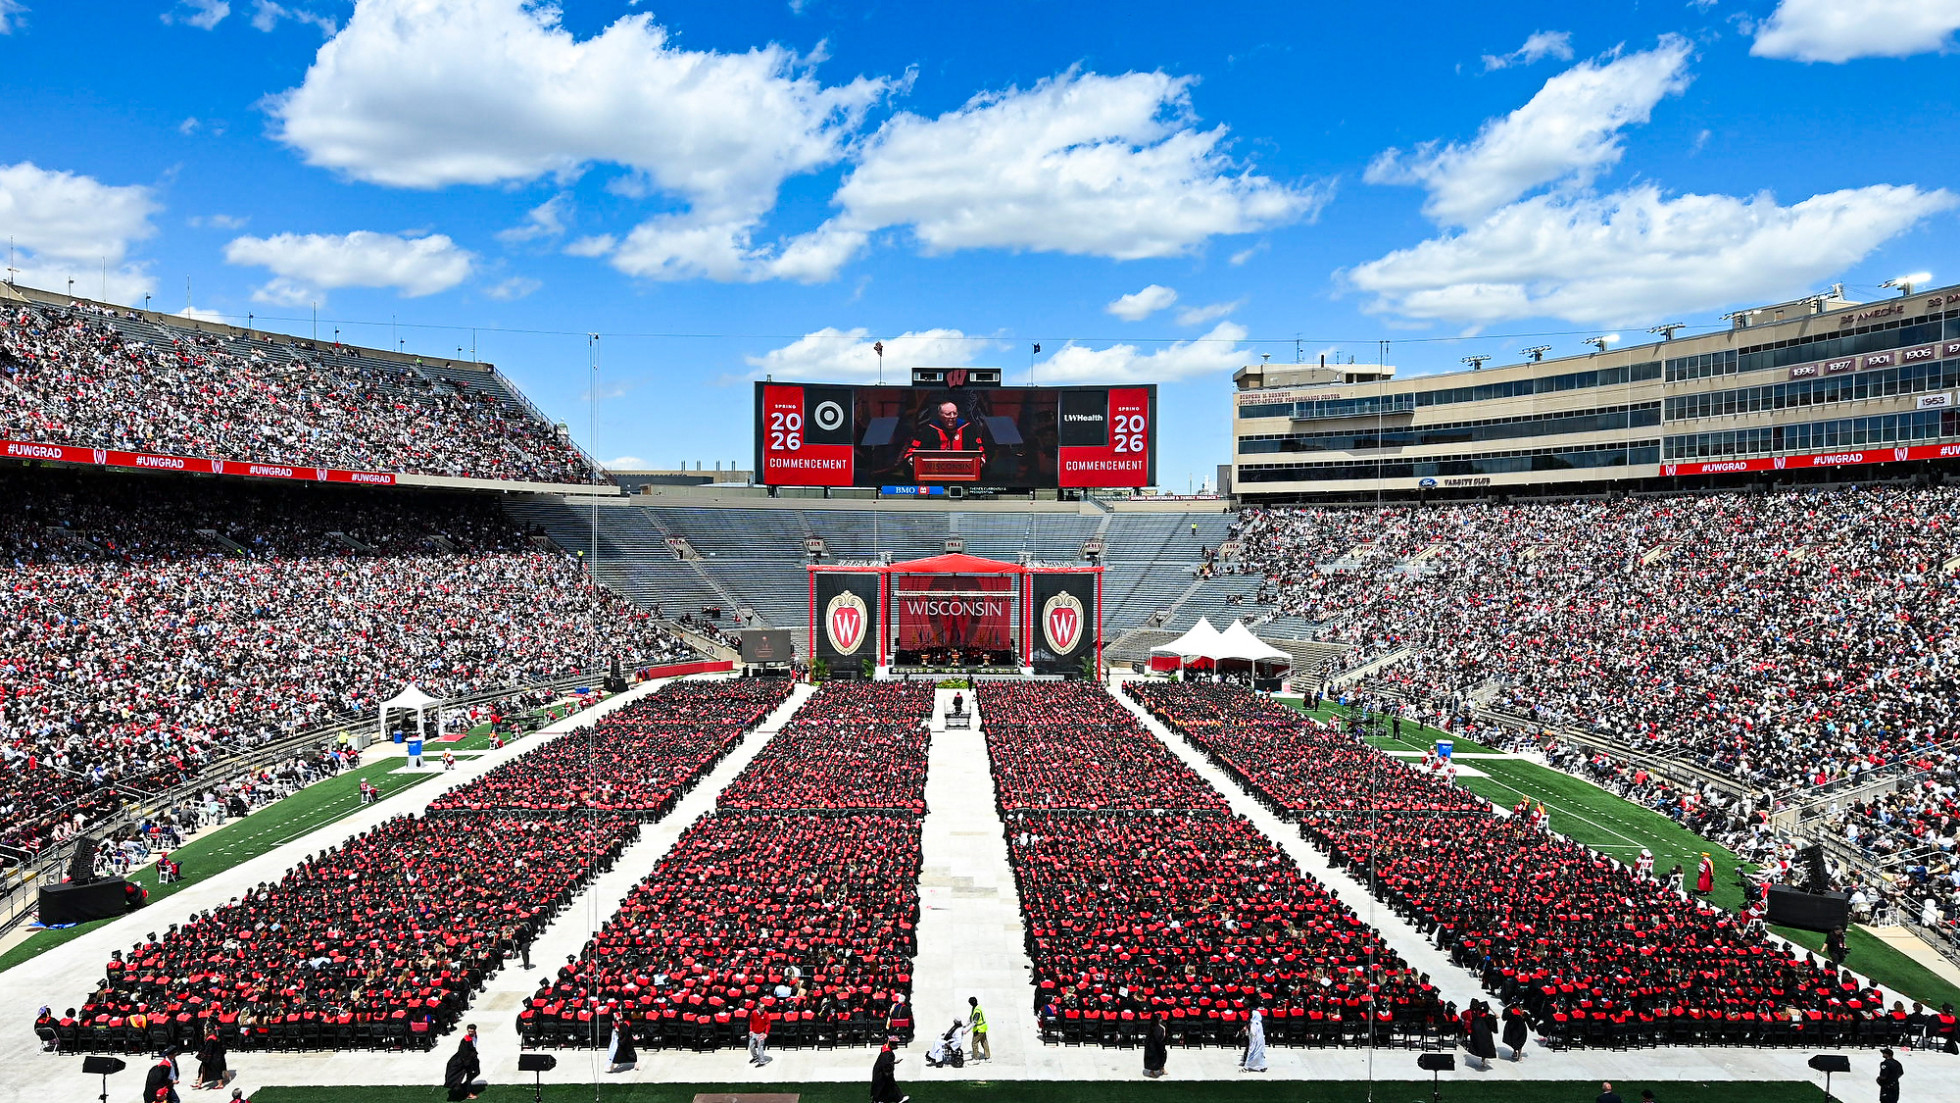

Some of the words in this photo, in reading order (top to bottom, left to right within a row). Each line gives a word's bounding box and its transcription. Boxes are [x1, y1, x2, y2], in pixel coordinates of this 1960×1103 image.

[1857, 304, 1905, 322] AMECHE
[1867, 354, 1890, 366] 1901
[1904, 348, 1932, 360] 1906
[1829, 360, 1852, 372] 1897
[1922, 397, 1946, 406] 1953
[770, 412, 802, 431] 20
[1114, 415, 1145, 433] 20
[770, 431, 801, 451] 26
[1114, 433, 1144, 453] 26
[8, 443, 62, 458] #UWGRAD
[136, 456, 184, 468] #UWGRAD
[769, 457, 847, 469] COMMENCEMENT
[1813, 453, 1863, 465] #UWGRAD
[250, 466, 292, 476] #UWGRAD
[1066, 460, 1143, 471] COMMENCEMENT
[1702, 461, 1747, 473] #UWGRAD
[352, 473, 391, 483] #UWGRAD
[1444, 478, 1473, 486] VARSITY
[1473, 477, 1491, 485] CLUB
[907, 601, 1002, 616] WISCONSIN
[835, 612, 858, 643] W
[1052, 612, 1075, 643] W
